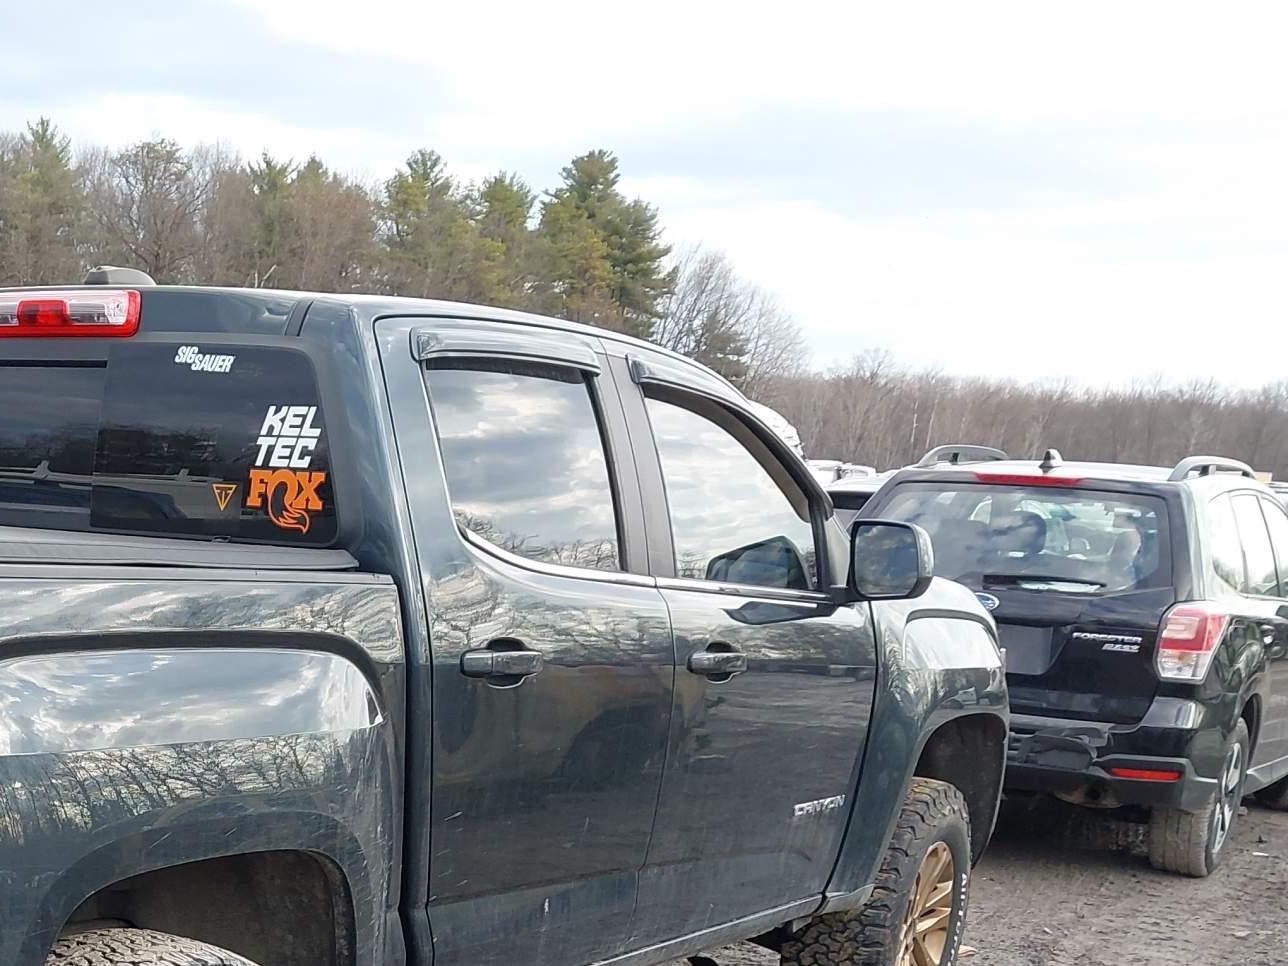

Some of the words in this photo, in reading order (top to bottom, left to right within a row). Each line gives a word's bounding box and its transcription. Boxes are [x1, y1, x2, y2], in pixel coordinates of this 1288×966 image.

[175, 346, 198, 363] SIG
[191, 355, 235, 373] SAUER
[260, 406, 321, 436] KEL
[255, 437, 318, 468] TEC
[246, 468, 326, 534] FOX
[1072, 632, 1143, 644] FORESTER
[792, 794, 846, 817] CANYON
